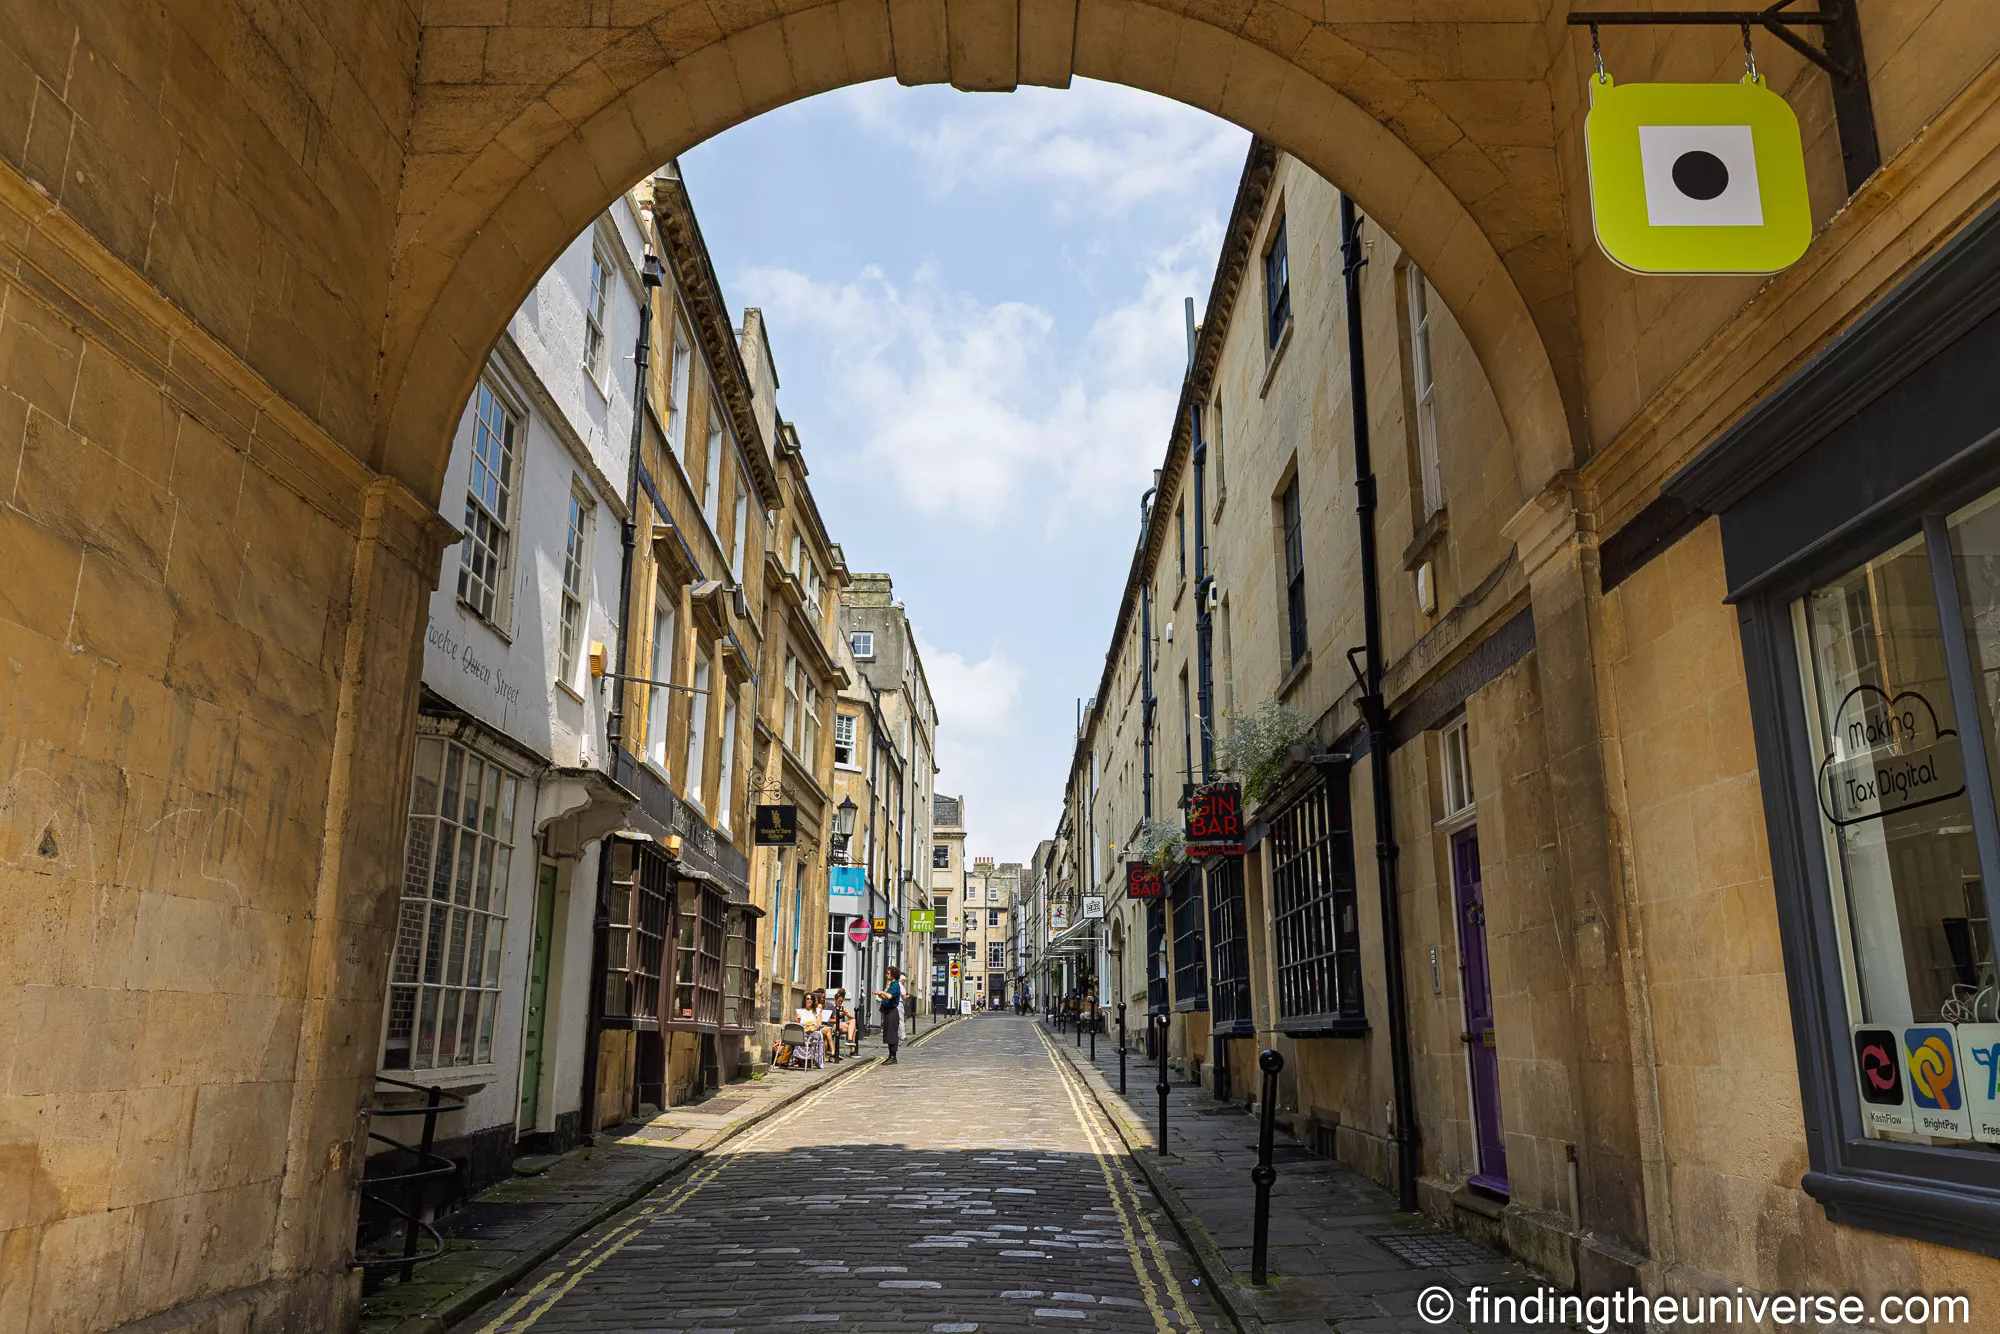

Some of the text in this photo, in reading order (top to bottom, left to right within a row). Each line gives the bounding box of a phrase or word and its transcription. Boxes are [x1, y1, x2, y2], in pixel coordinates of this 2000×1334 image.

[462, 645, 491, 686] Queen
[494, 668, 520, 706] Street
[1846, 754, 1938, 806] Tax Digital
[1191, 795, 1235, 816] GIN
[1191, 815, 1239, 837] BAR
[1131, 869, 1159, 883] GIN
[1131, 882, 1161, 896] BAR
[1870, 1112, 1902, 1125] KashFlow
[1923, 1117, 1959, 1132] BrightPay
